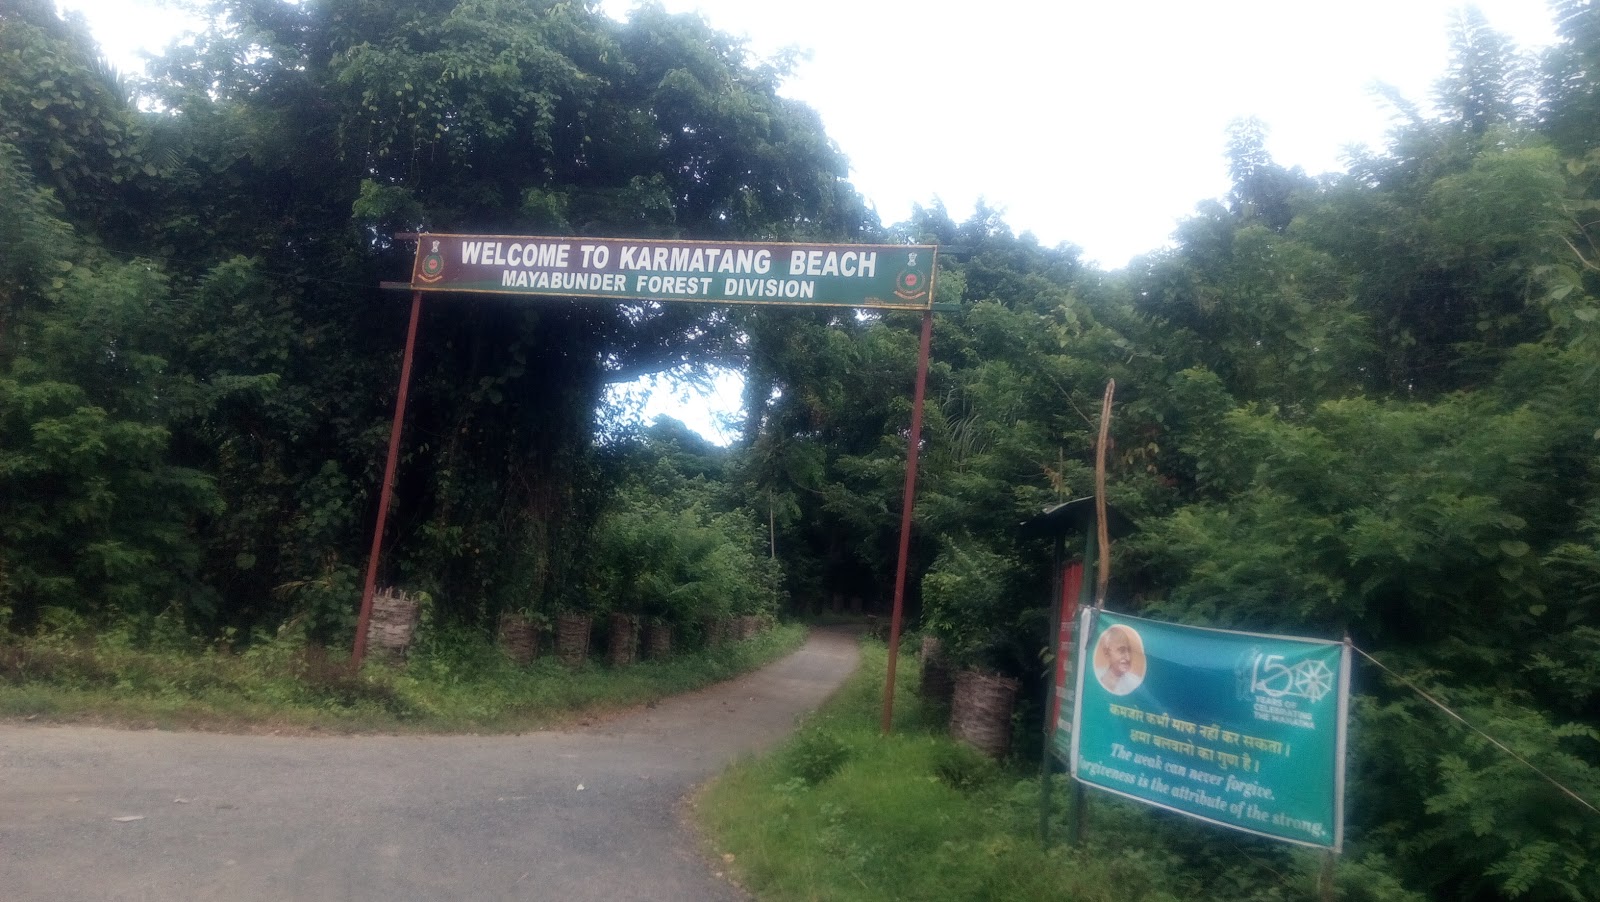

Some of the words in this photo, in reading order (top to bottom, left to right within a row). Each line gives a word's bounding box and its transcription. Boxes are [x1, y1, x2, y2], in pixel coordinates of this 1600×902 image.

[461, 241, 570, 267] WELCOME
[580, 245, 609, 269] TO
[619, 246, 771, 274] KARMATANG
[789, 250, 877, 277] BEACH
[502, 270, 626, 291] MAYABUNDER
[636, 275, 712, 294] FOREST
[724, 278, 815, 298] DIVISION
[1145, 711, 1170, 728] कभी
[1221, 730, 1240, 745] कर
[1196, 746, 1214, 761] का
[1110, 743, 1132, 761] The
[1133, 753, 1163, 770] weak
[1164, 761, 1187, 777] can
[1188, 768, 1224, 786] never
[1225, 774, 1275, 801] forgive.
[1137, 772, 1150, 788] is
[1150, 777, 1170, 794] the
[1171, 785, 1227, 811] attribute
[1230, 801, 1246, 818] of
[1246, 803, 1270, 822] the
[1272, 812, 1327, 838] strong.
